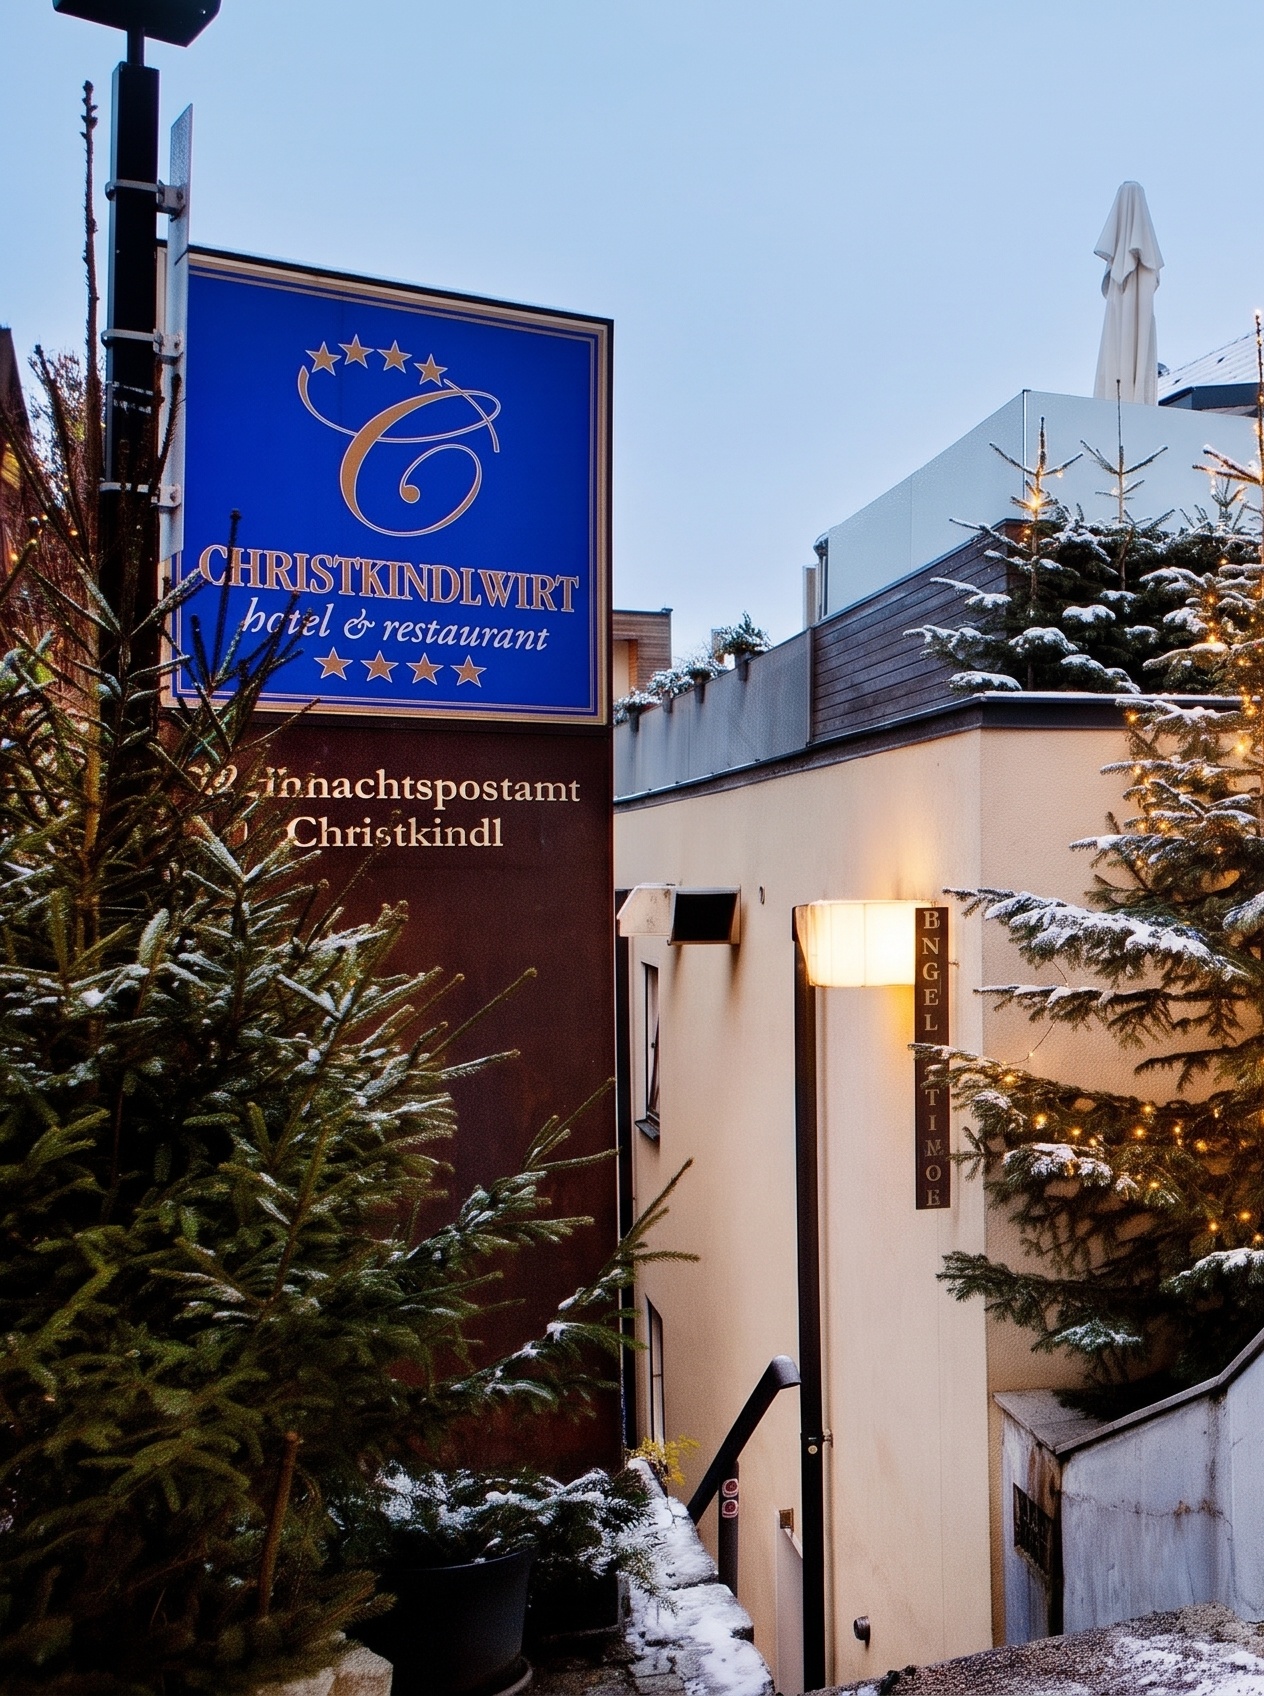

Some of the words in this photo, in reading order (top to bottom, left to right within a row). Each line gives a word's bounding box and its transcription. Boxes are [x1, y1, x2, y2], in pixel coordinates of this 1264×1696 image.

[199, 544, 579, 612] CHRISTKINDLWIRT
[242, 597, 334, 636] hotel
[343, 608, 375, 640] &
[383, 620, 549, 650] restaurant
[287, 816, 503, 847] Christkindl
